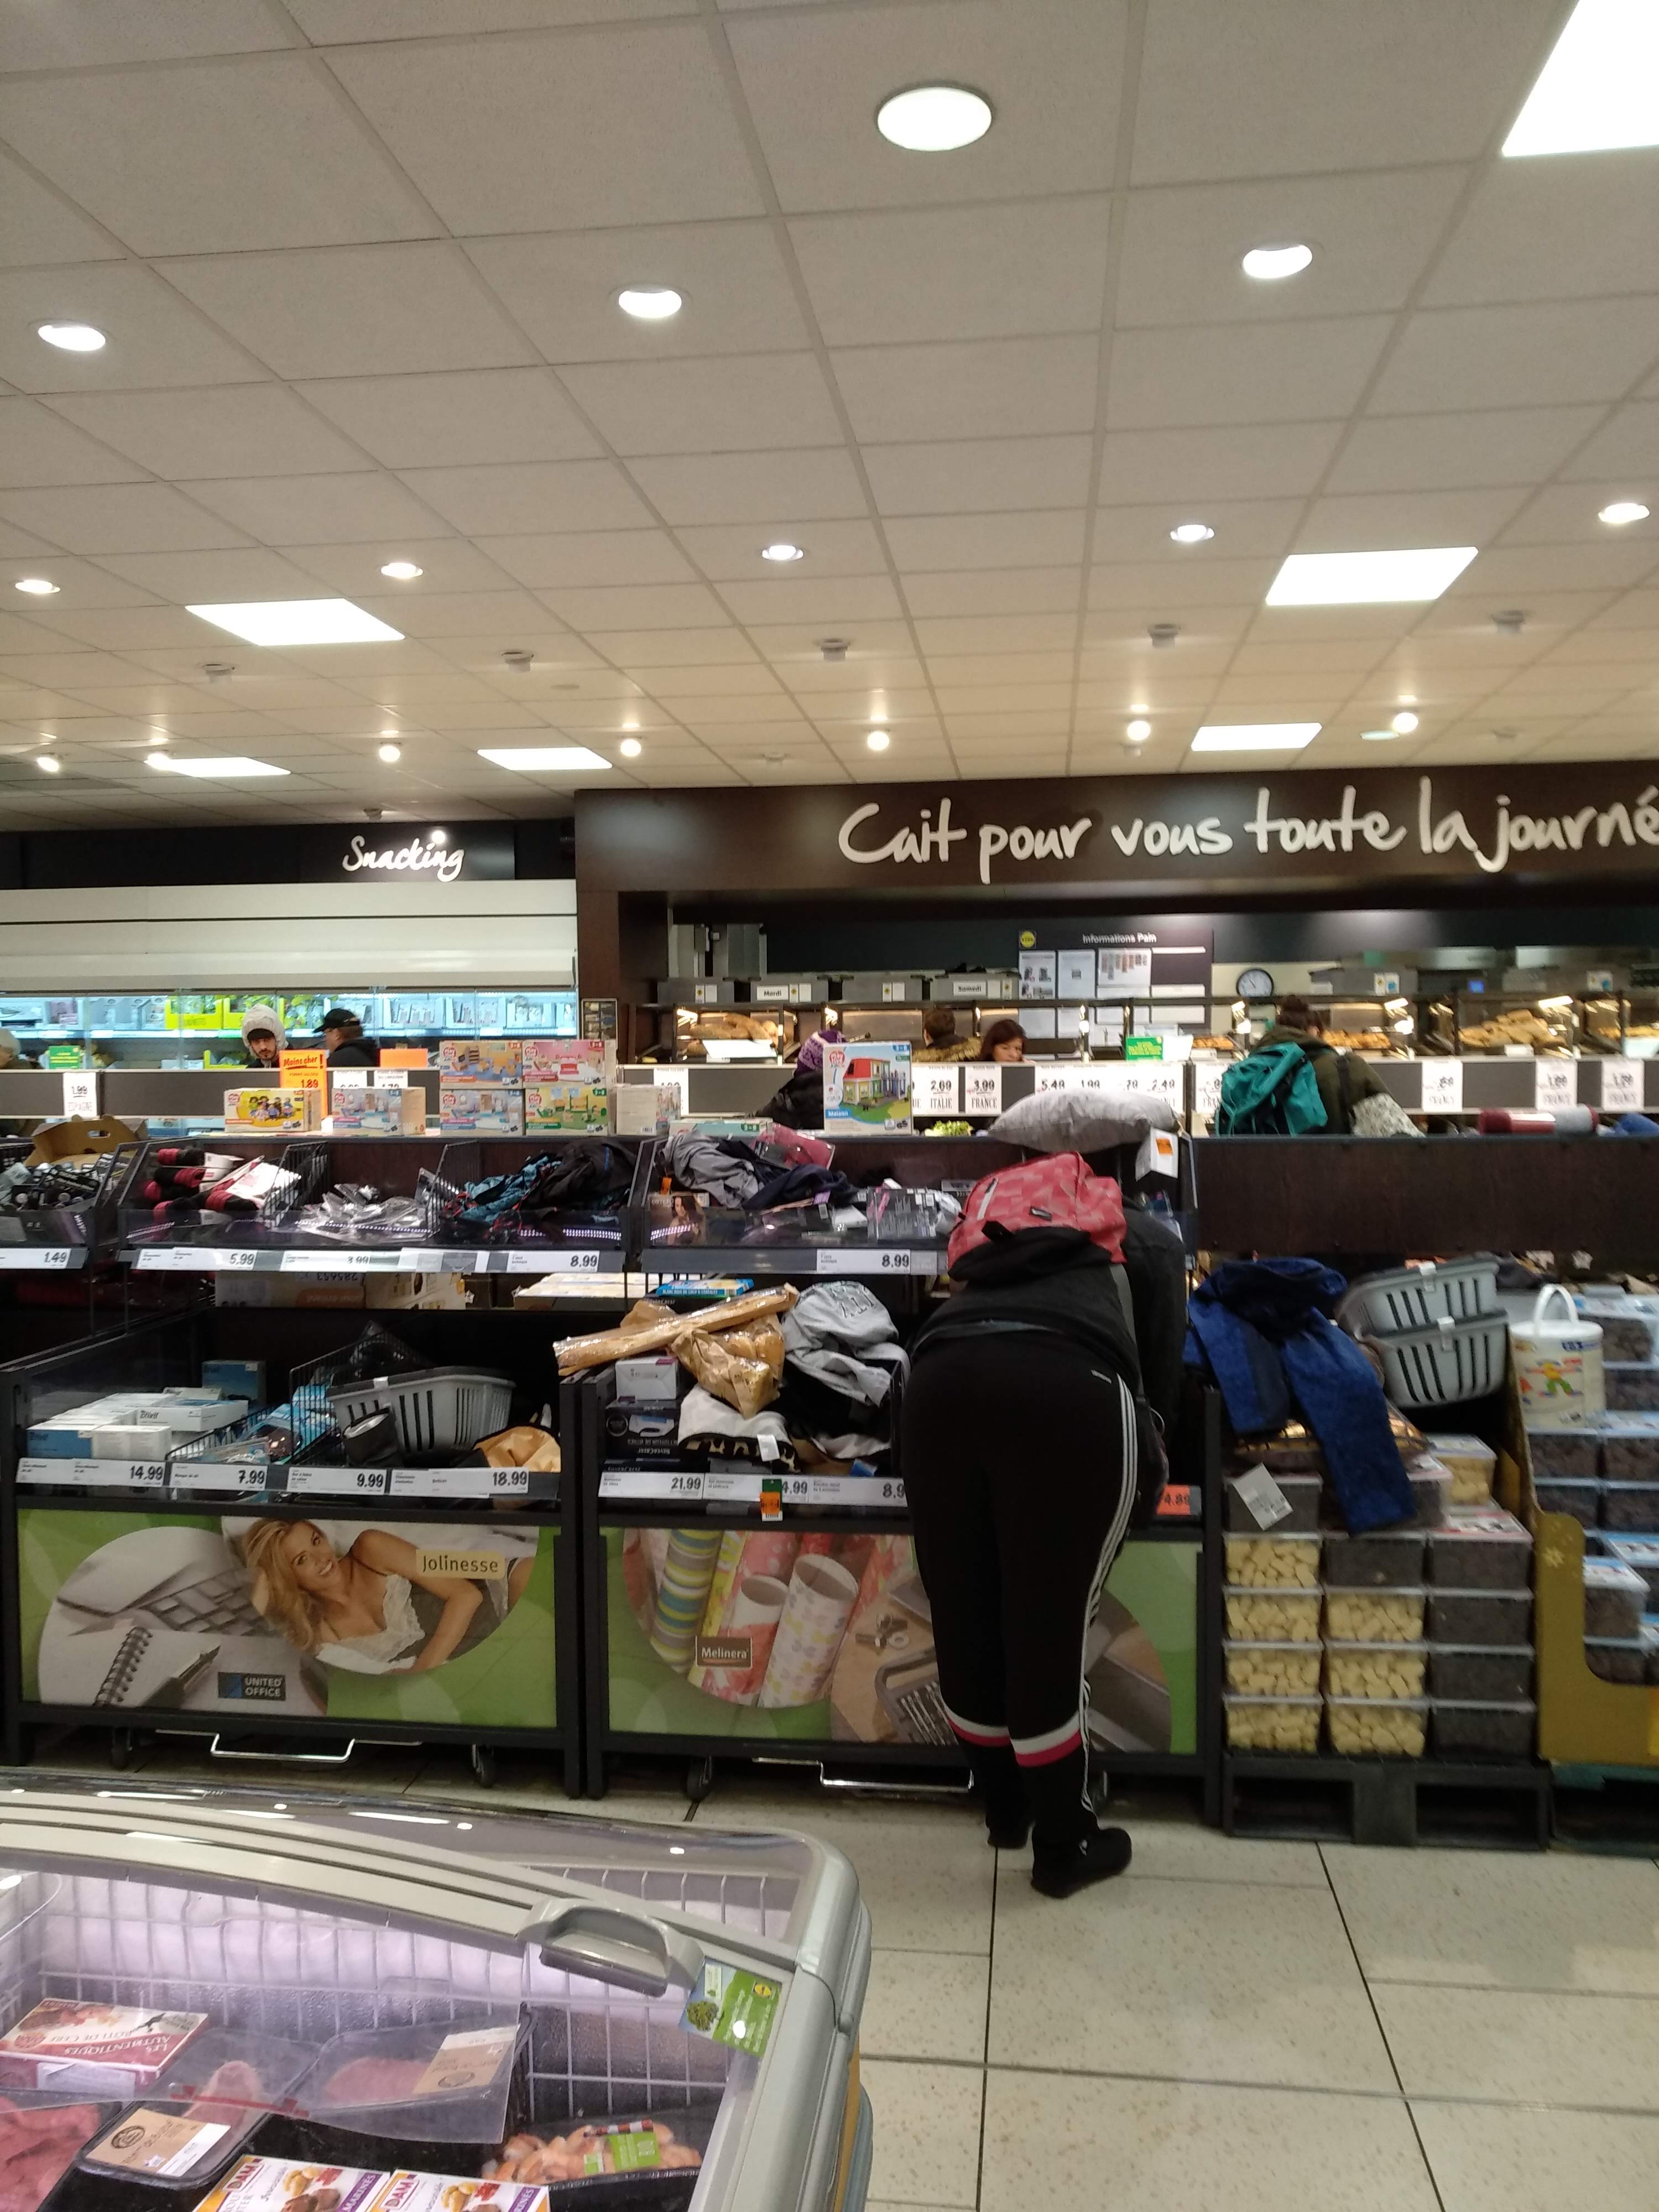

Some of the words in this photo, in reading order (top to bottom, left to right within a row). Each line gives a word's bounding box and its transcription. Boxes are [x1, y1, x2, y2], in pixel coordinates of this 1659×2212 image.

[838, 797, 967, 863] Cuit
[979, 817, 1093, 885] pour
[1110, 818, 1234, 856] vous
[1244, 786, 1407, 853] toute
[1418, 775, 1477, 854] la
[342, 835, 465, 882] Snacking
[1082, 933, 1135, 943] Informations
[1137, 932, 1157, 943] Pain
[304, 1055, 317, 1064] cher
[930, 1097, 953, 1110] ITALIE
[972, 1097, 998, 1109] FRANCE
[881, 1254, 910, 1268] 8.99
[130, 1465, 163, 1480] 14.99
[238, 1469, 265, 1484] 7.99
[493, 1472, 527, 1486] 18.99
[357, 1473, 383, 1488] 9.99
[671, 1477, 701, 1490] 21.99
[423, 1554, 498, 1573] Jolinesse
[701, 1647, 748, 1659] Melinera
[244, 1677, 283, 1687] UNITED
[244, 1687, 281, 1697] OFFICE
[64, 2035, 172, 2056] AUTHENTIQUES
